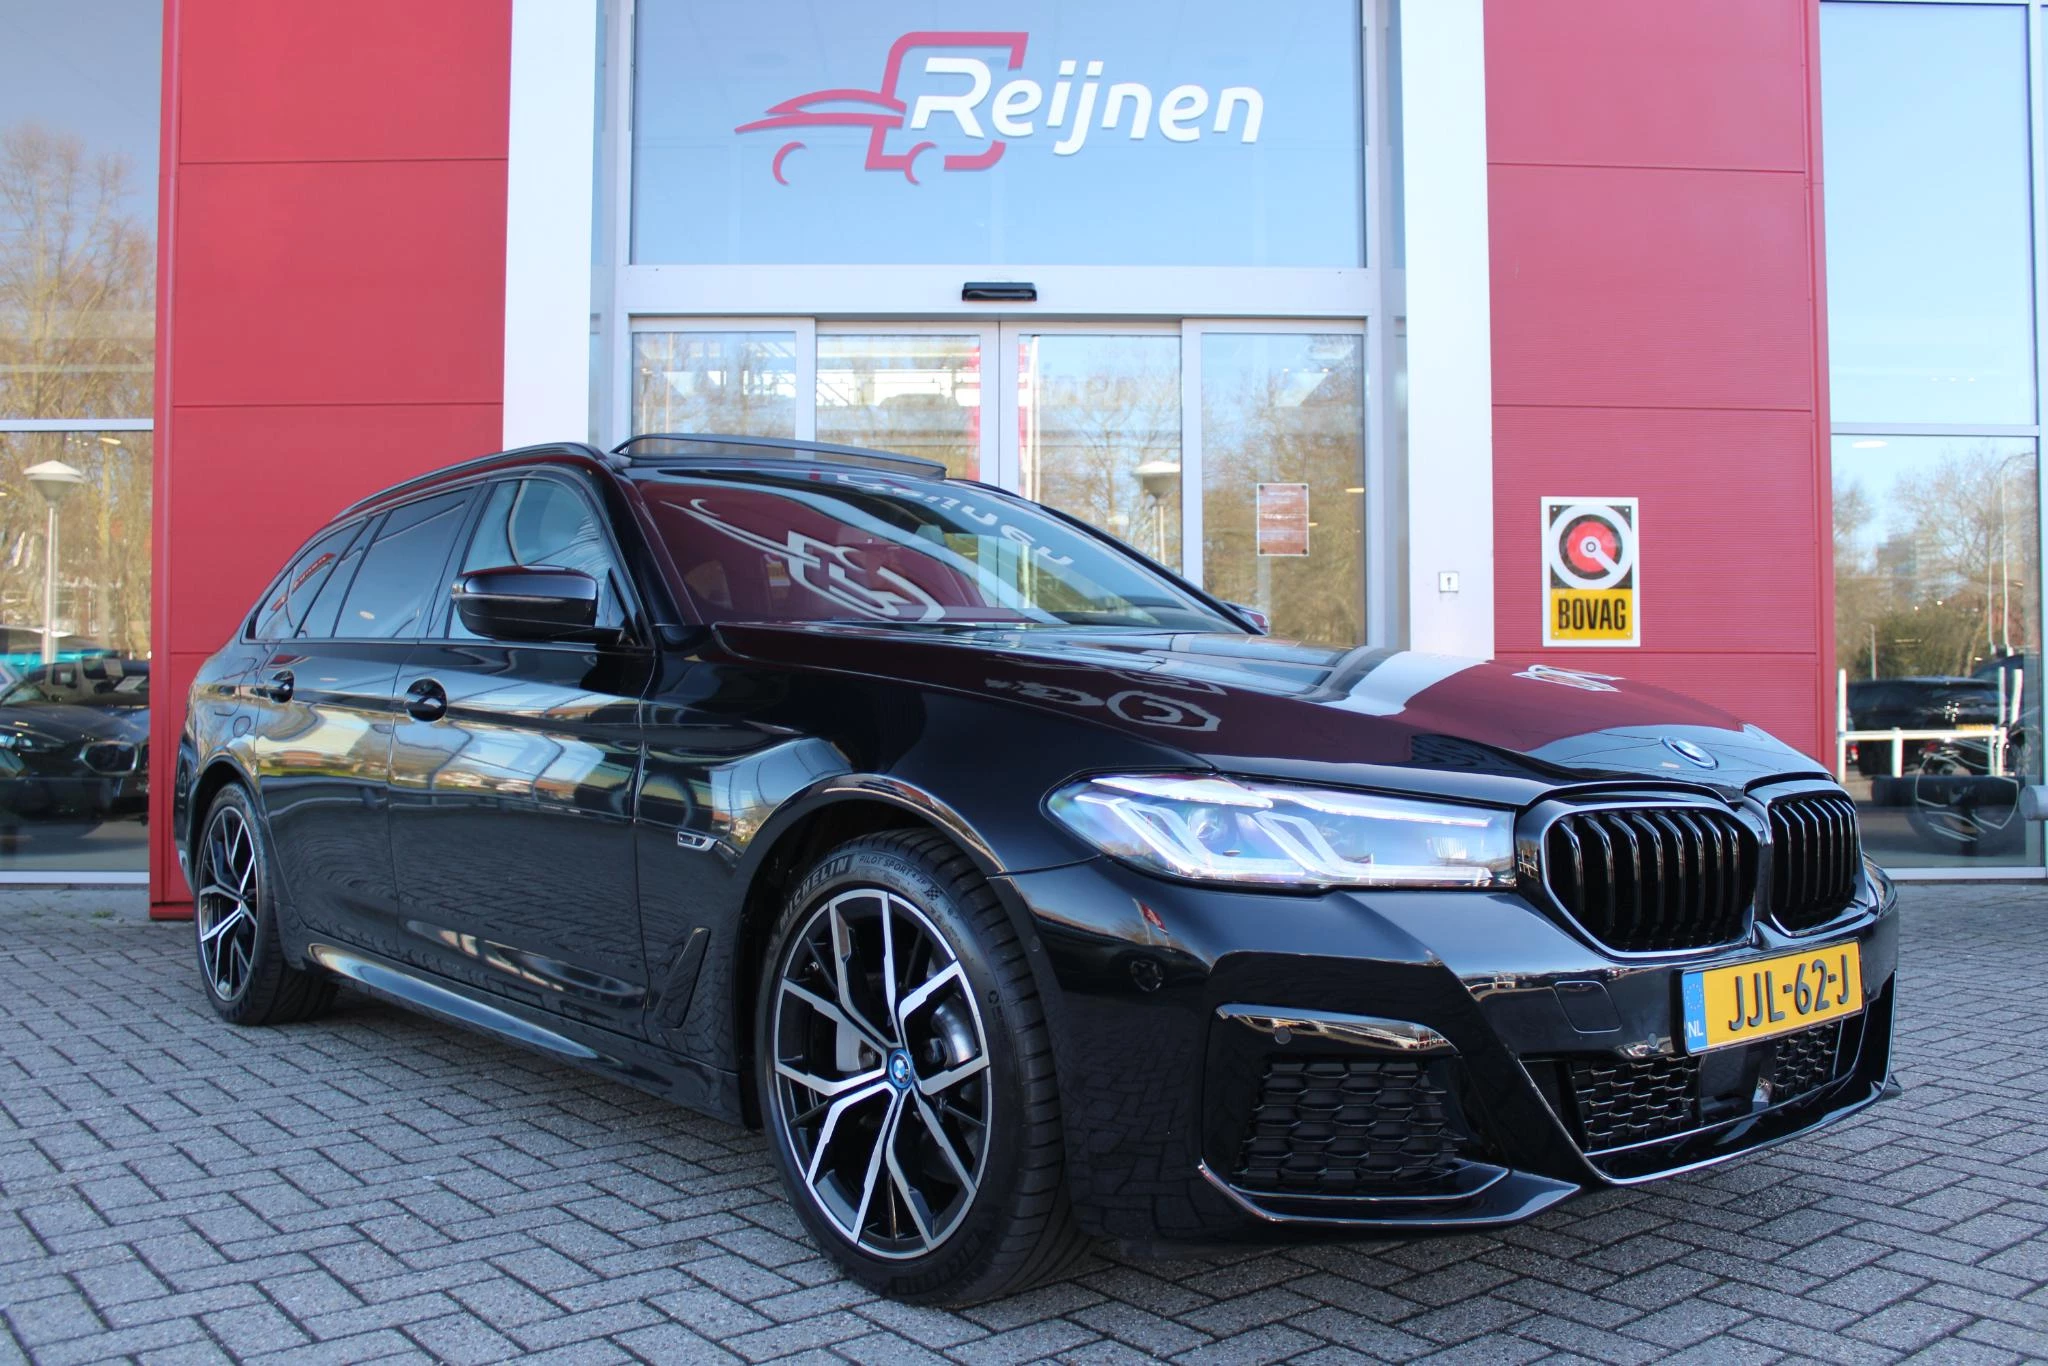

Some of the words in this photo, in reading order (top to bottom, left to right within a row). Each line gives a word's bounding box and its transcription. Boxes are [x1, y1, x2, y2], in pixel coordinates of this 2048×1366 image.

[910, 57, 1264, 155] Reijnen
[1558, 598, 1626, 631] BOVAG
[859, 855, 884, 865] PILOT
[884, 857, 912, 876] SPORT
[779, 856, 849, 931] MICHELIN
[1728, 954, 1849, 1031] JJL-62-J
[1687, 1020, 1704, 1038] NL
